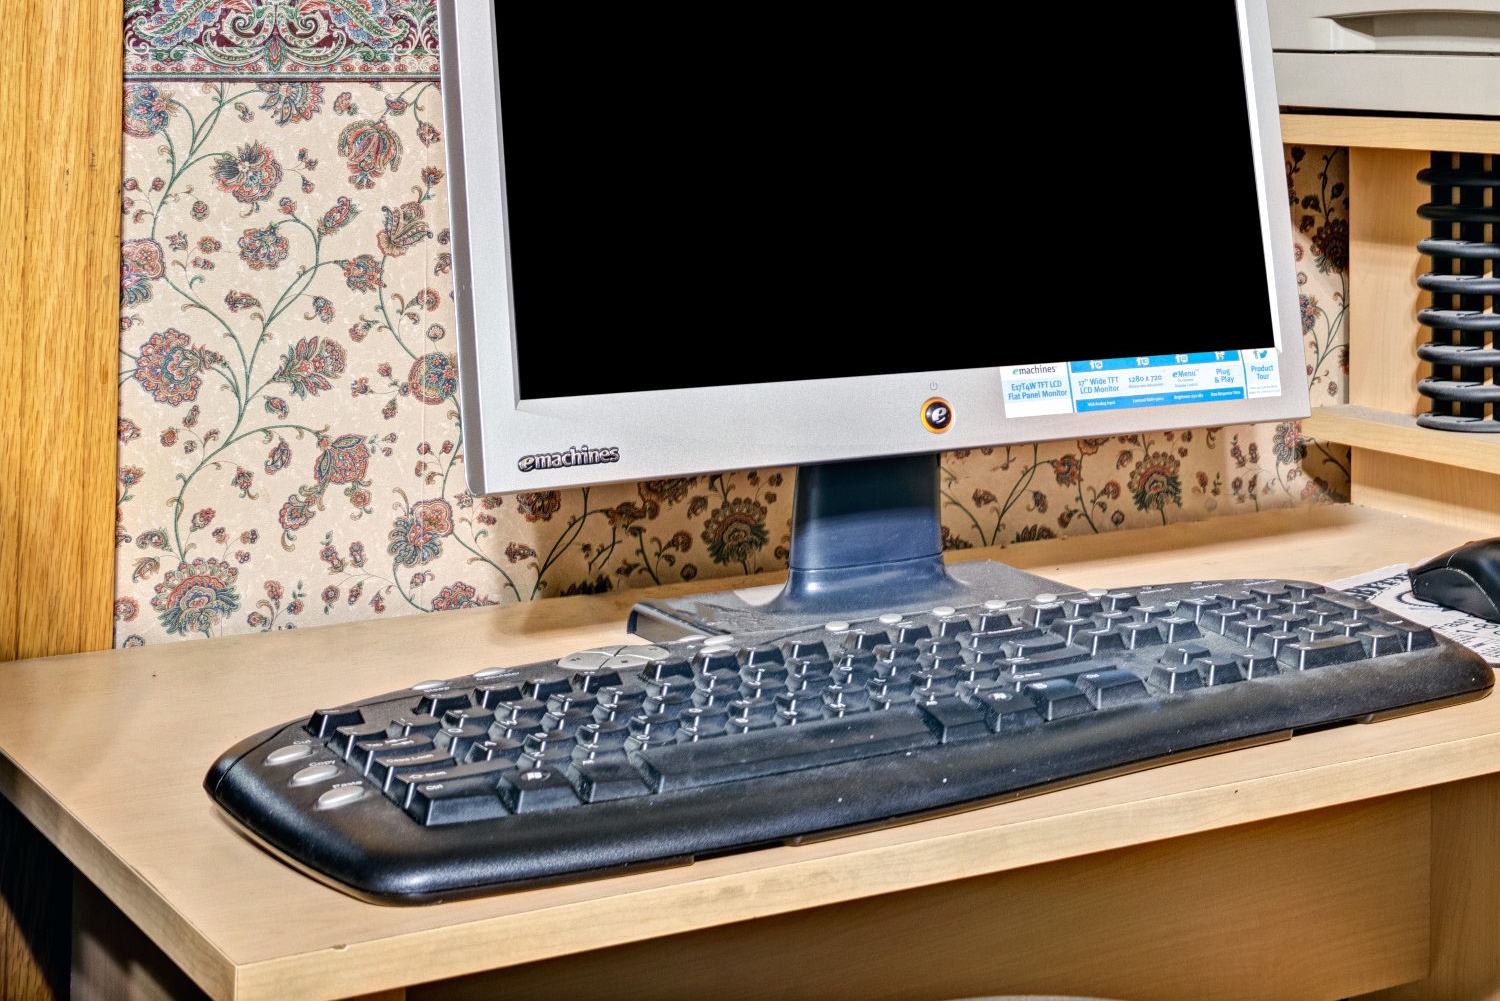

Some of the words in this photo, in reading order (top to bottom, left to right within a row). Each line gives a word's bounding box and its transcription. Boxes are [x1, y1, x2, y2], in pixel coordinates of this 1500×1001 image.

[1012, 365, 1056, 375] emachines
[1216, 368, 1231, 376] Plug
[1090, 378, 1106, 386] Wide
[1107, 376, 1119, 384] TFT
[1221, 376, 1235, 384] Play
[1256, 373, 1270, 381] Tour
[1037, 381, 1049, 389] TFT
[1050, 380, 1063, 388] LCD
[1080, 386, 1093, 395] LCD
[1094, 385, 1120, 393] Monitor
[1008, 392, 1021, 401] Flat
[1021, 391, 1041, 399] Panel
[1042, 389, 1067, 398] Monitor
[518, 445, 620, 472] emachines
[309, 759, 336, 767] Copy
[332, 780, 363, 789] Paste
[425, 784, 444, 792] Ctrl
